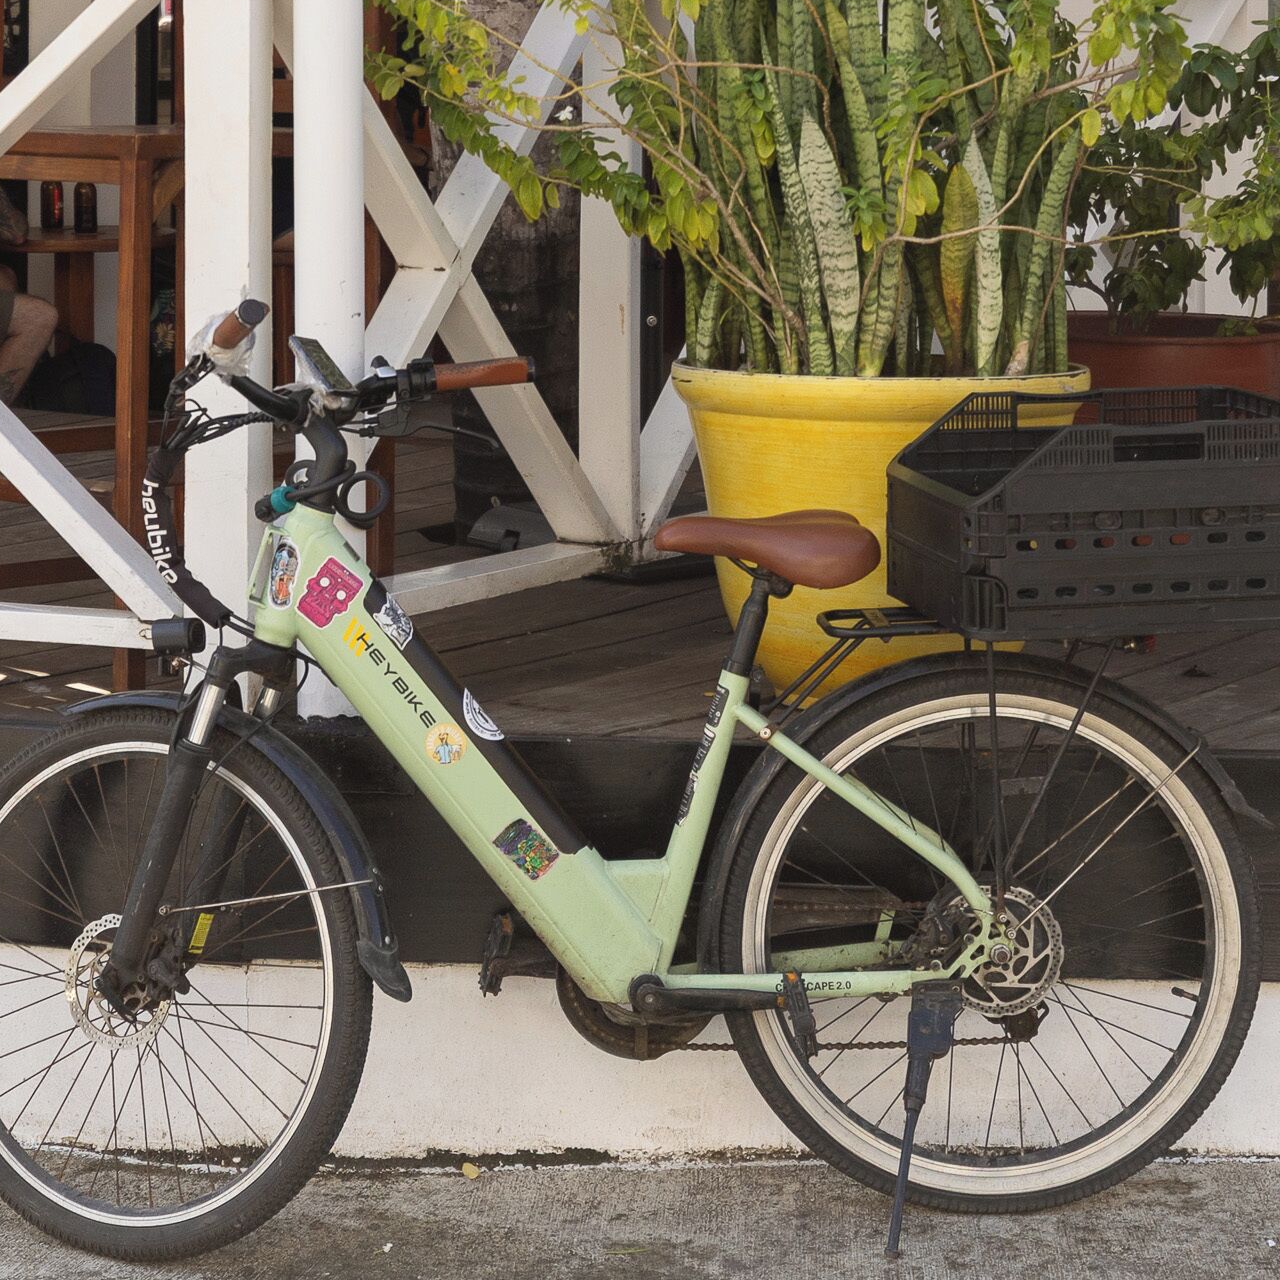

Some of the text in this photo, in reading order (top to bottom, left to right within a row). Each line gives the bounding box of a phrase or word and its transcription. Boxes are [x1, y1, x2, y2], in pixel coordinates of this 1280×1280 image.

[142, 478, 178, 584] heybike
[356, 632, 437, 729] HEYBIKE
[775, 981, 852, 992] CCAPE 2.0
